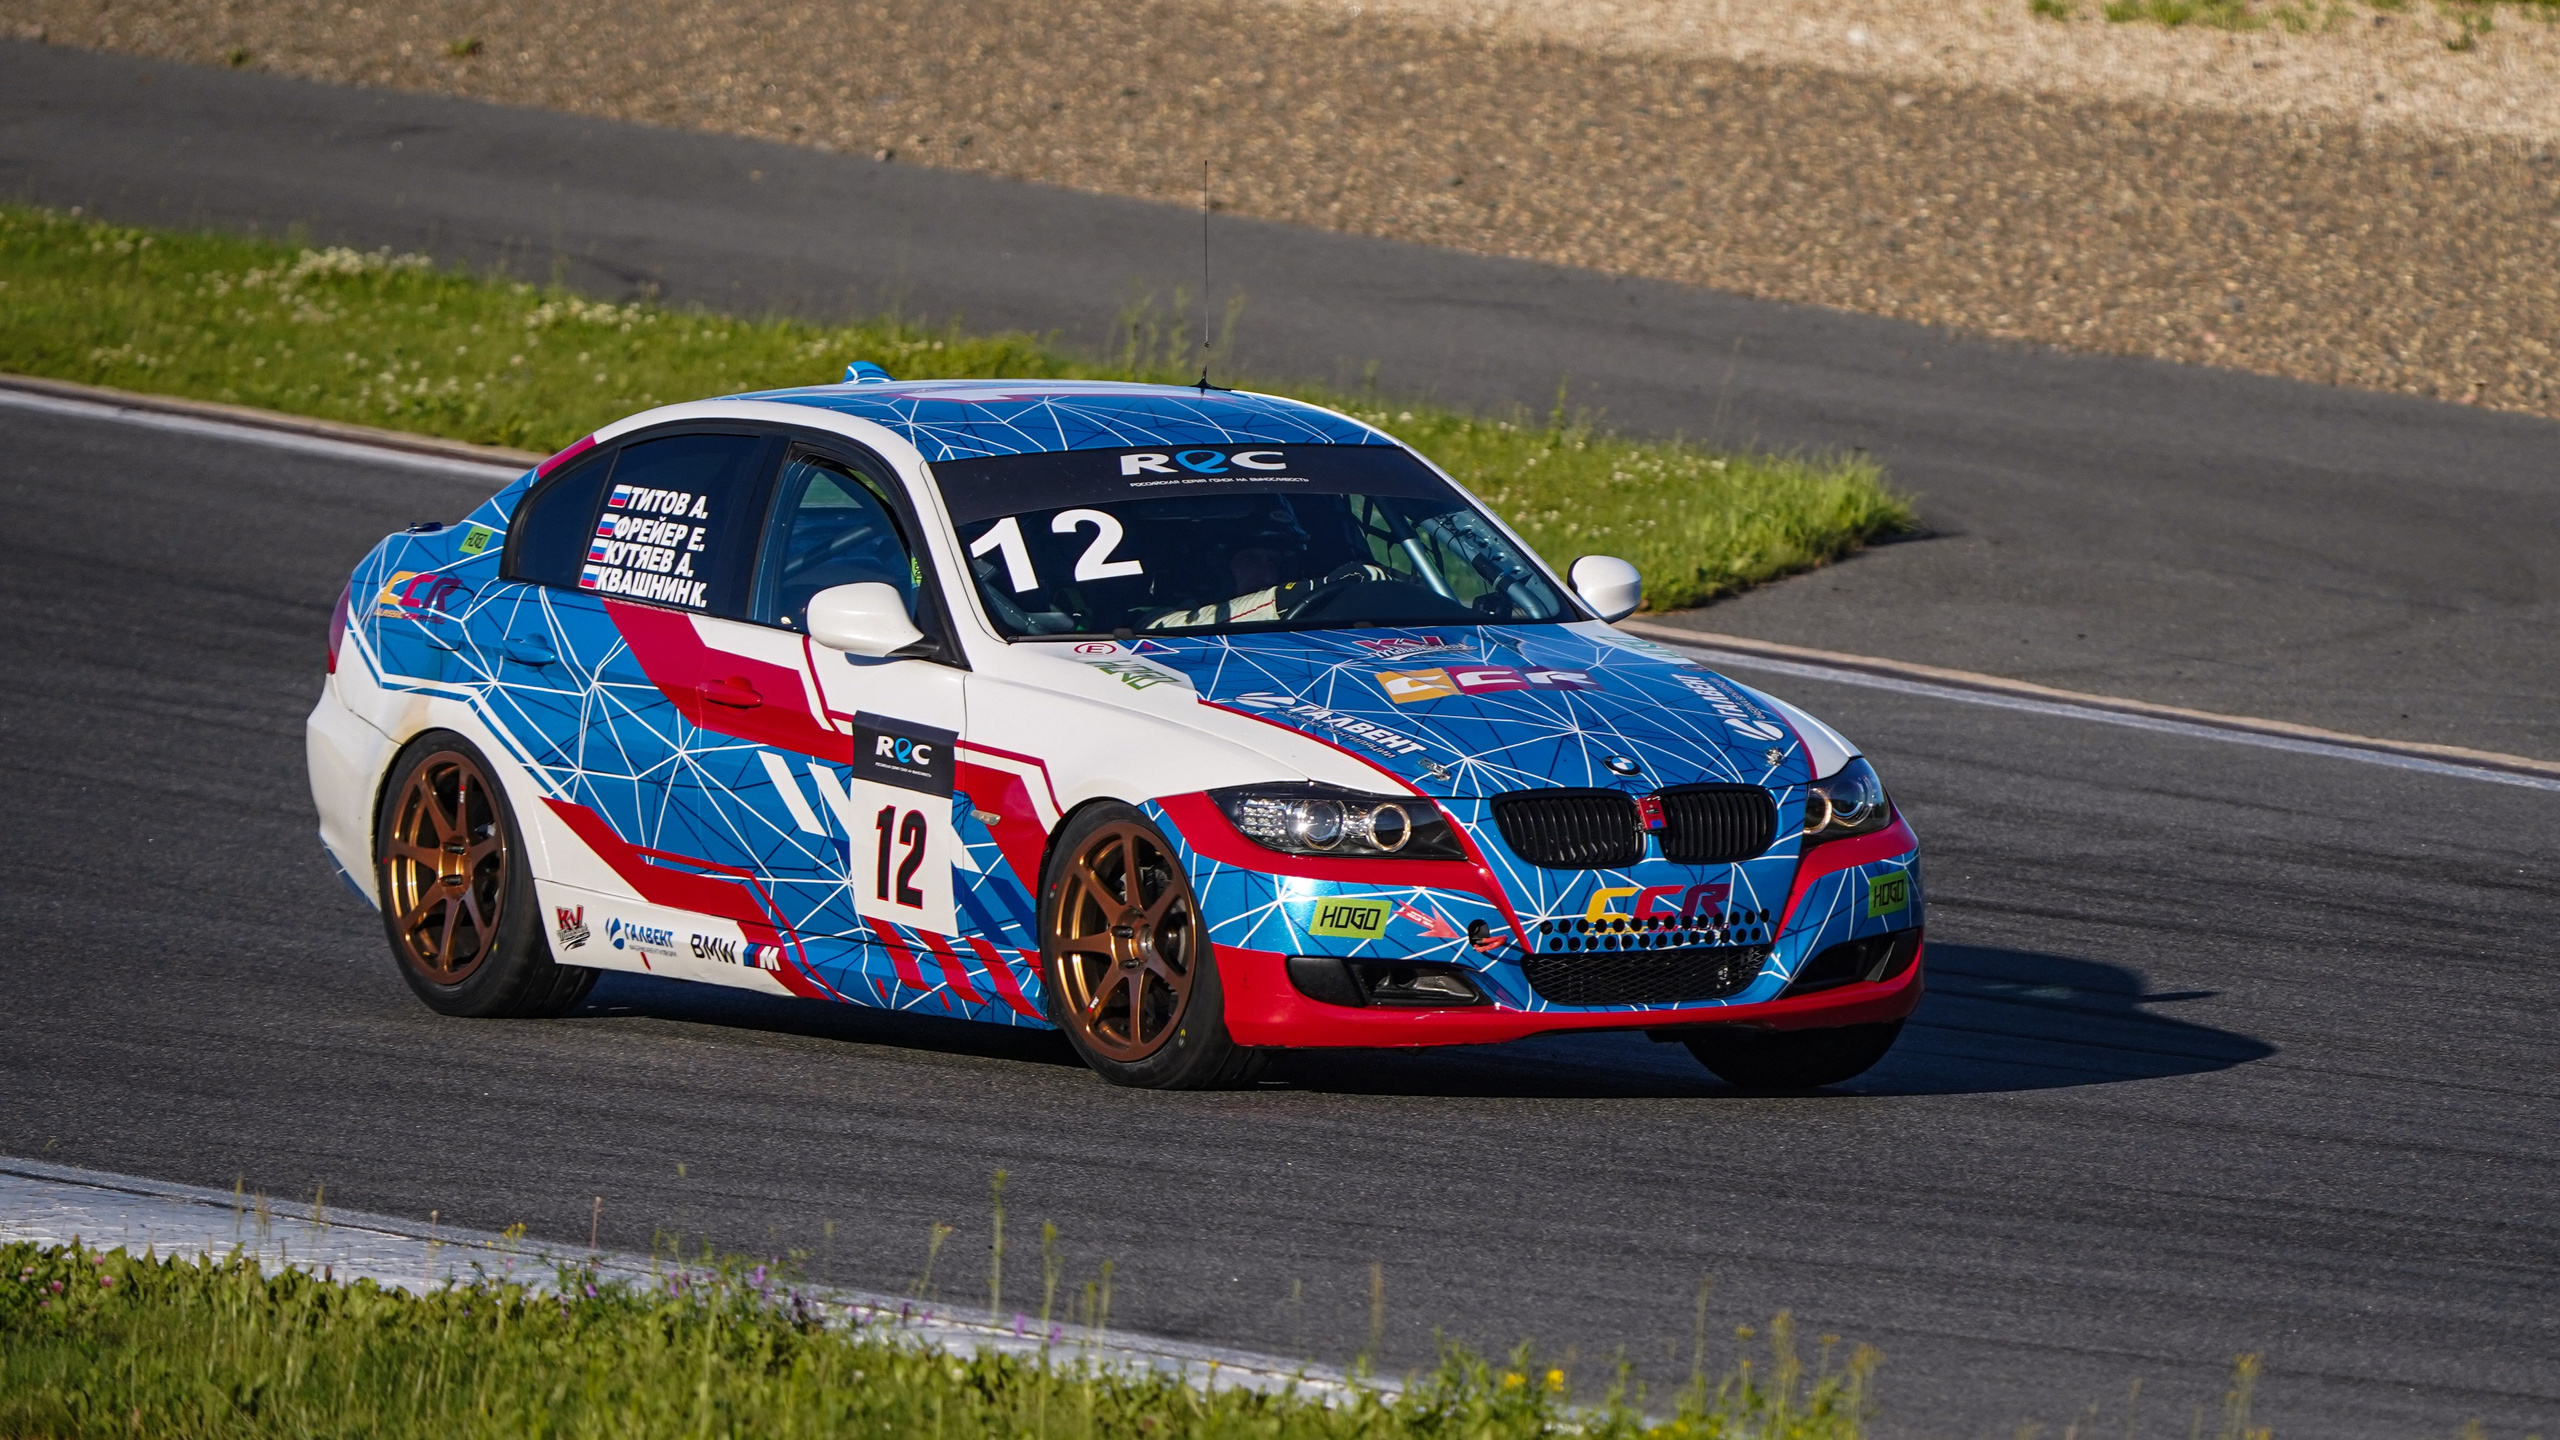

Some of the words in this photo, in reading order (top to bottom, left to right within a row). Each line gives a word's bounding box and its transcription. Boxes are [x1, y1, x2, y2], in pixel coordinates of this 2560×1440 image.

[627, 486, 691, 515] ТИТОВ
[688, 495, 708, 519] А.
[614, 516, 688, 547] ФРЕЙЕР
[687, 527, 706, 551] Е.
[969, 508, 1143, 593] 12
[603, 540, 675, 573] КУТЯЕВ
[674, 552, 694, 577] А.
[595, 566, 693, 604] КВАШНИН
[1288, 704, 1428, 755] ГАЛВЕНТ
[876, 804, 927, 910] 12
[1585, 883, 1732, 923] CCR
[1873, 879, 1905, 908] HOGO
[625, 922, 674, 948] ГАЛВЕНТ
[1319, 905, 1381, 930] HOGO
[690, 933, 737, 964] BMW
[759, 945, 781, 972] M
